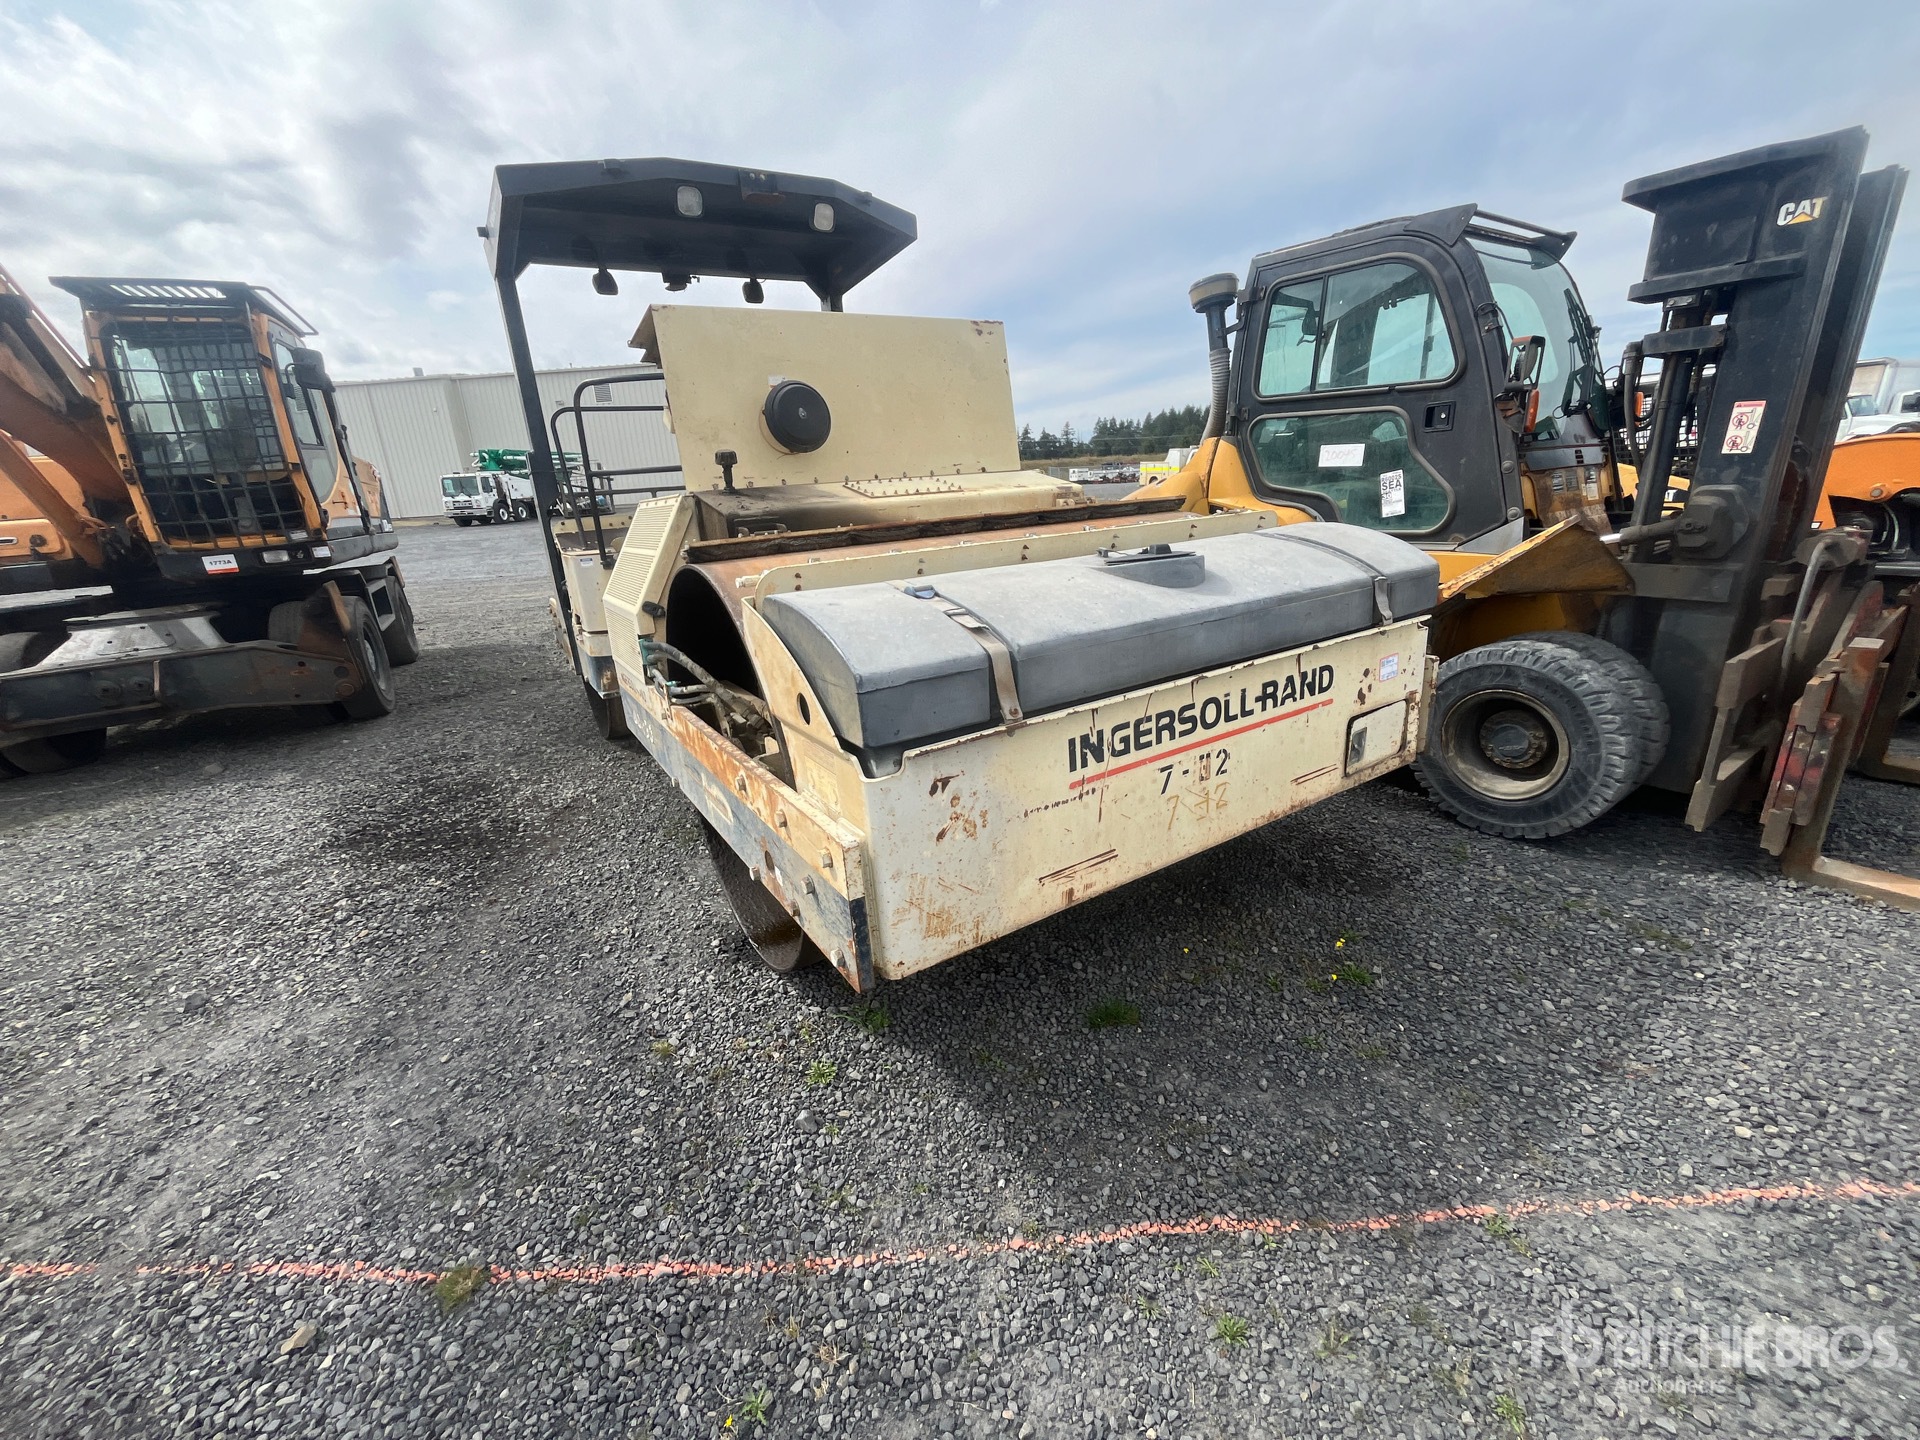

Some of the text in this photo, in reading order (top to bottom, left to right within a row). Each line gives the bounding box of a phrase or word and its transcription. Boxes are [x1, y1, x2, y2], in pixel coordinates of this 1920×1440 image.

[1776, 196, 1829, 226] CAT
[1381, 479, 1402, 491] SEA
[1068, 664, 1334, 773] INGERSOLL-RAND
